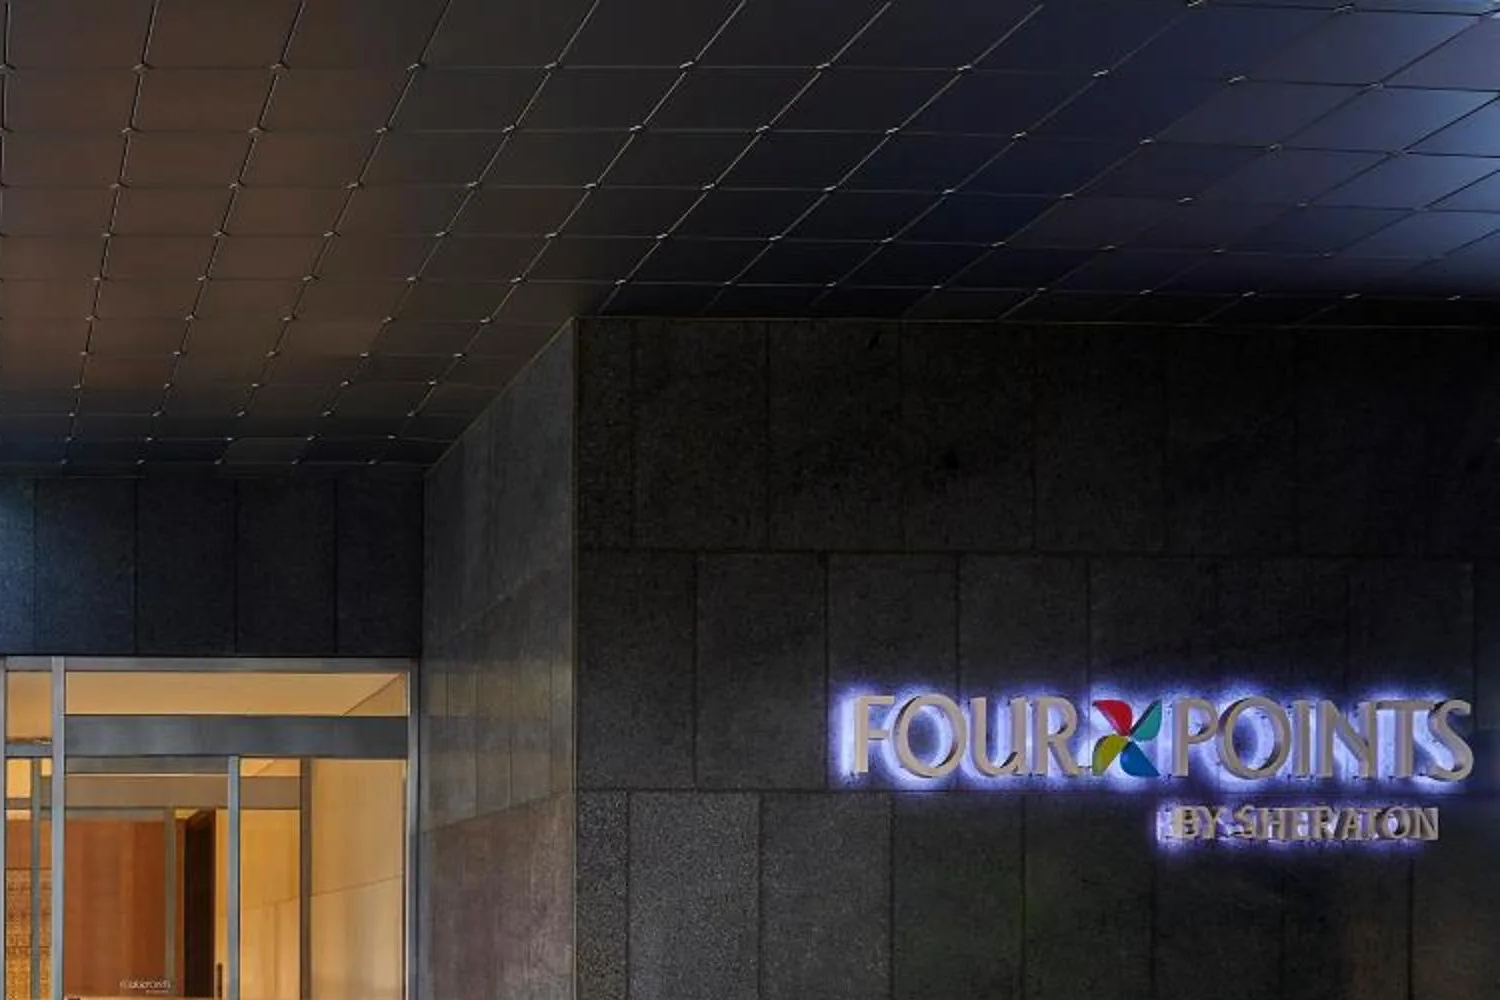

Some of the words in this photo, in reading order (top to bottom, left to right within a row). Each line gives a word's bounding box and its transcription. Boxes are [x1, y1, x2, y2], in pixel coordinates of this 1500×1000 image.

[854, 693, 1080, 778] FOUR
[1171, 696, 1474, 781] POINTS
[1172, 805, 1218, 840] BY
[1233, 804, 1439, 841] SHERATON
